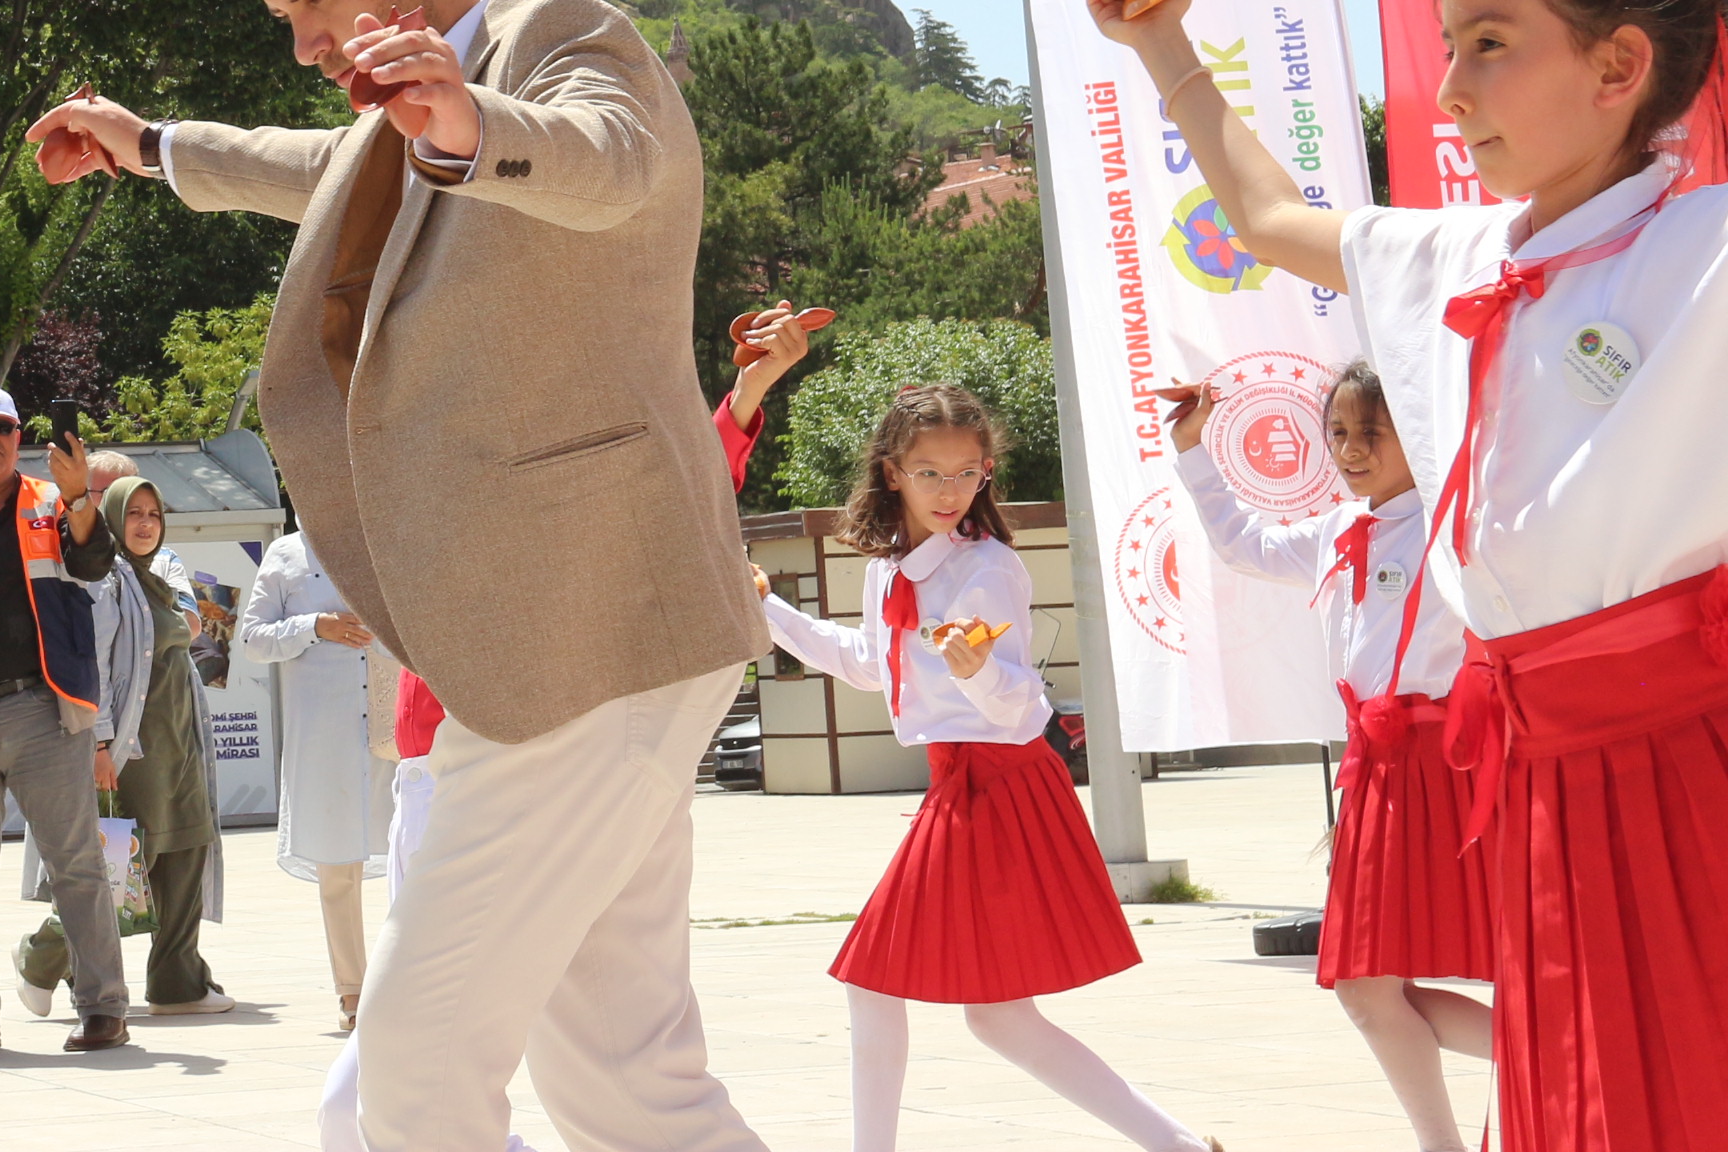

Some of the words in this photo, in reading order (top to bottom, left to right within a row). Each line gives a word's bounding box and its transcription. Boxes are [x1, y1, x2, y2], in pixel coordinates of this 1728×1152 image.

[1084, 80, 1128, 184] VALİLİĞİ
[1288, 99, 1323, 171] değer
[1602, 345, 1632, 374] SIFIR
[1595, 356, 1625, 383] ATIK
[1220, 413, 1230, 425] VE
[229, 711, 257, 722] ŞEHRİ
[213, 723, 258, 733] RAHİSAR
[220, 736, 259, 747] YILLIK
[216, 748, 260, 760] MİRASI
